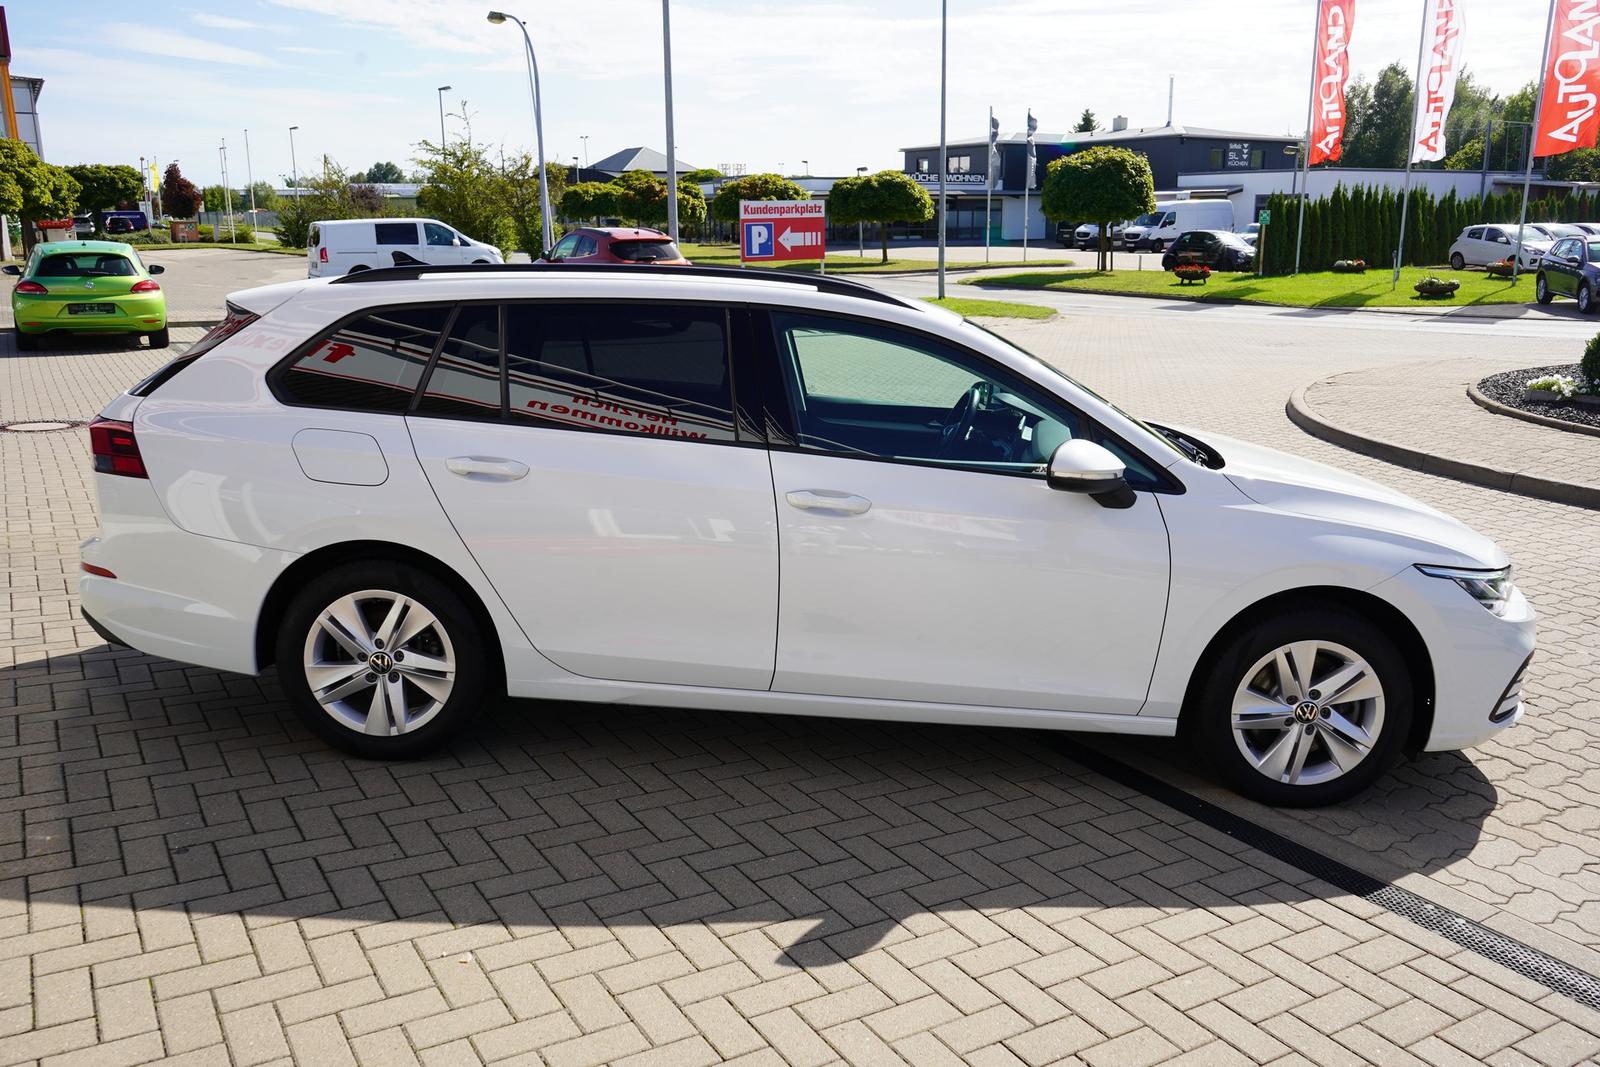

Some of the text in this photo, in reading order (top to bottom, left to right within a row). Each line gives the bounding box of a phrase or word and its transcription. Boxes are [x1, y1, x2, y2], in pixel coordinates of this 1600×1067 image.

[946, 174, 985, 182] WOHNEN
[743, 204, 823, 216] Kundenparkplatz
[751, 225, 769, 255] P
